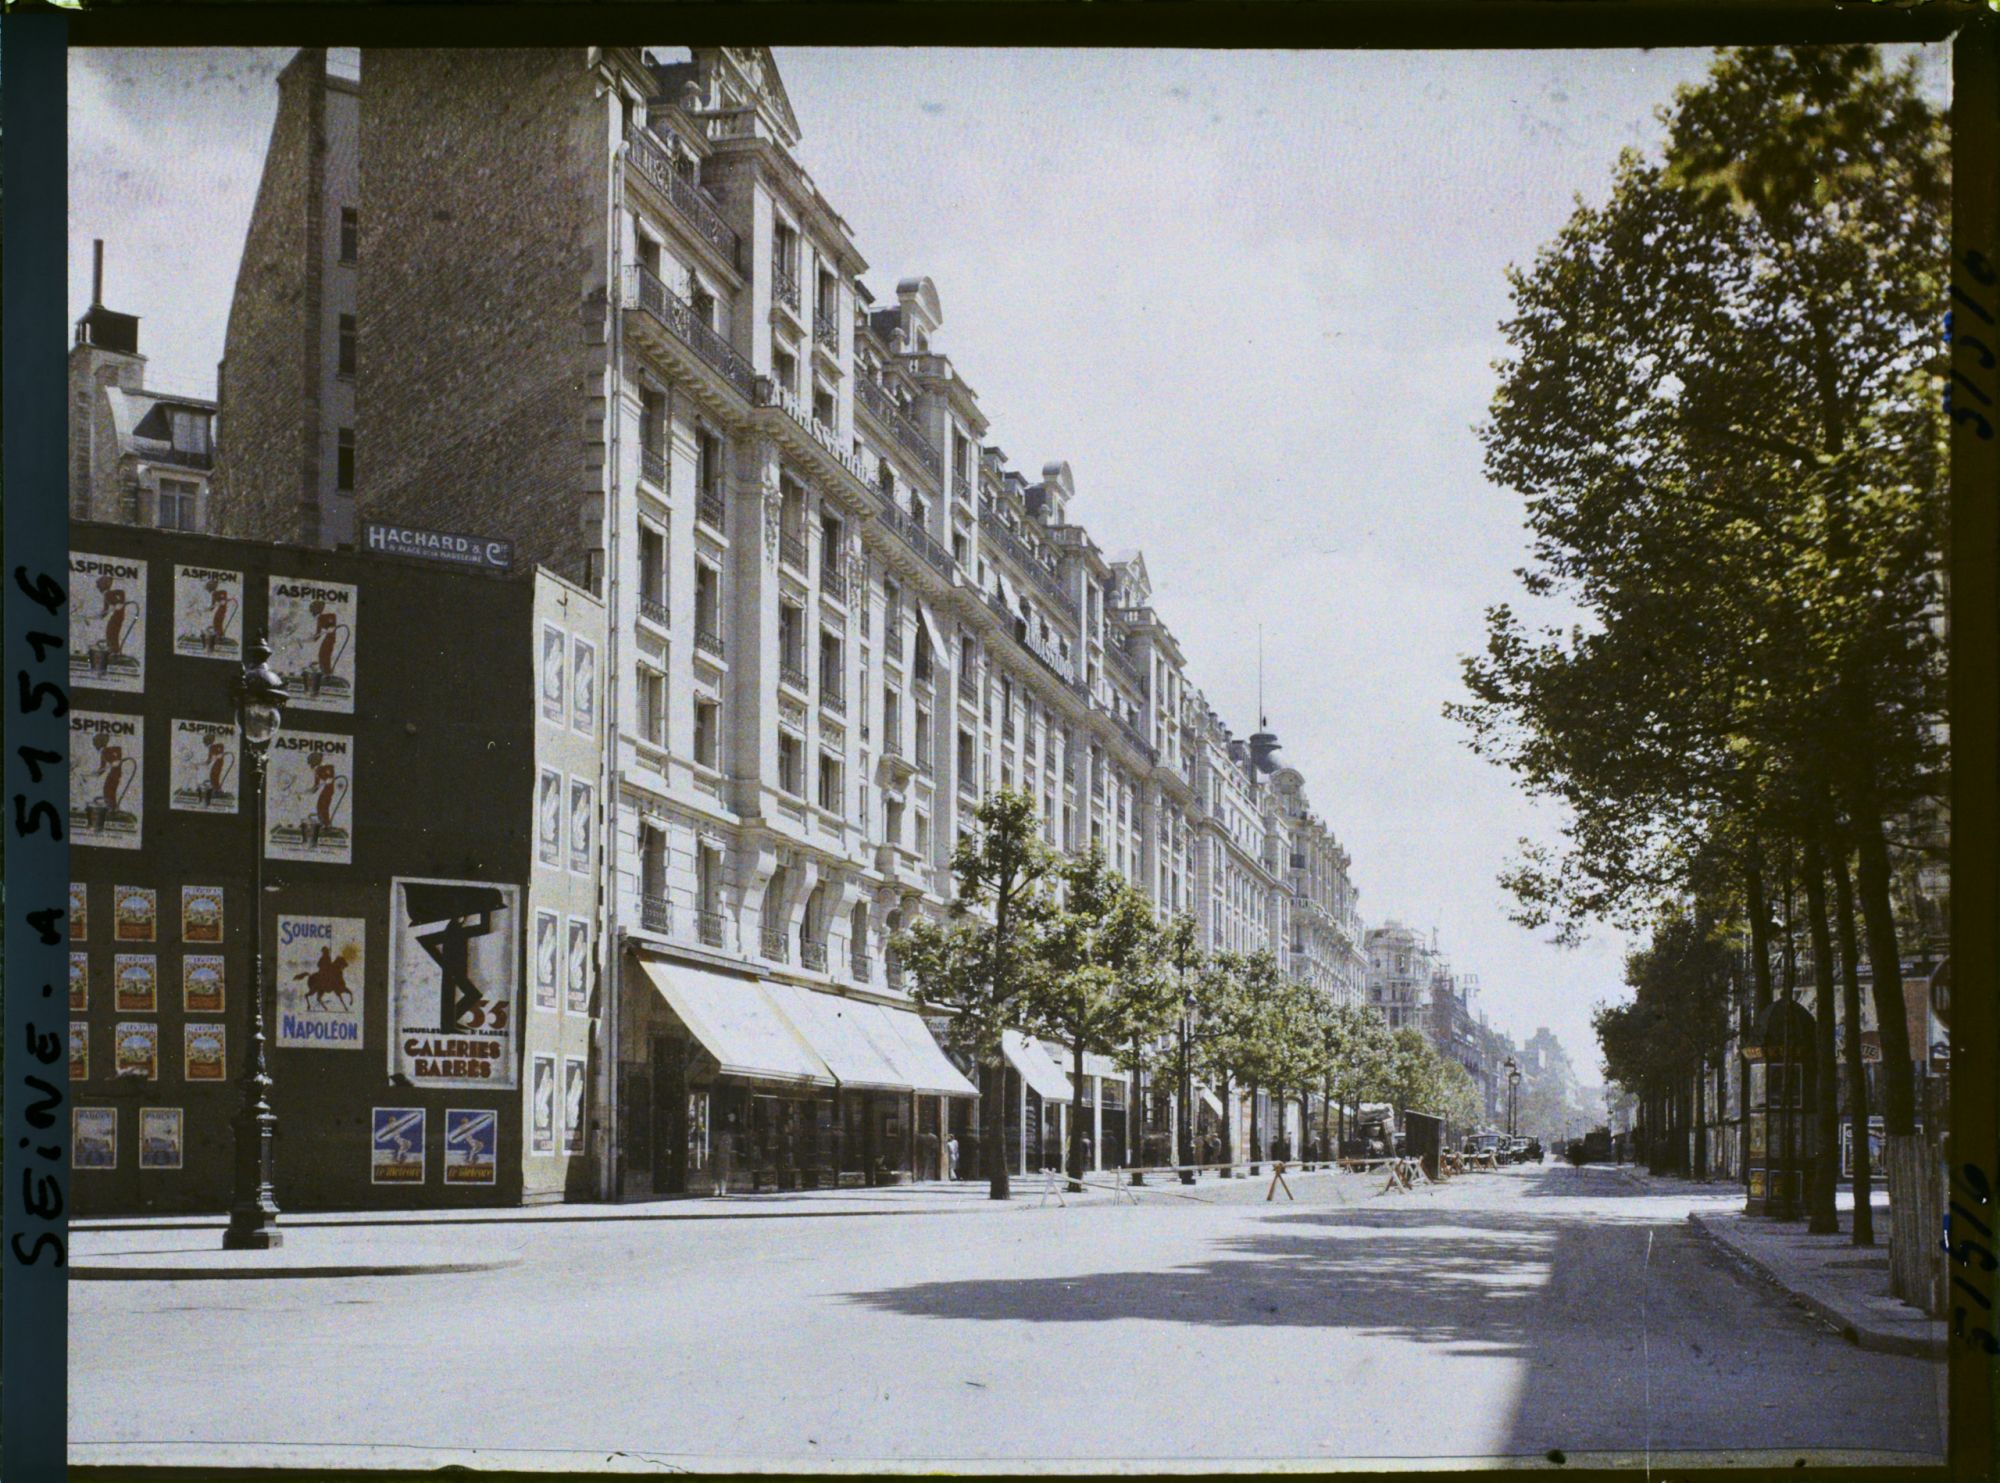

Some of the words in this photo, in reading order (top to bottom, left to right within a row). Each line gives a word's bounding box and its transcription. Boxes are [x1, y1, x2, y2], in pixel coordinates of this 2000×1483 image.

[369, 526, 468, 552] HACHARD
[472, 544, 481, 554] &
[398, 545, 421, 556] PLACE
[181, 567, 237, 582] ASPIRON
[277, 584, 349, 603] ASPIRON
[178, 721, 235, 736] ASPIRON
[275, 736, 347, 754] ASPIRON
[281, 921, 332, 945] SOURCE
[283, 1015, 358, 1041] NAPOLÉON
[404, 1039, 500, 1059] GALERIES
